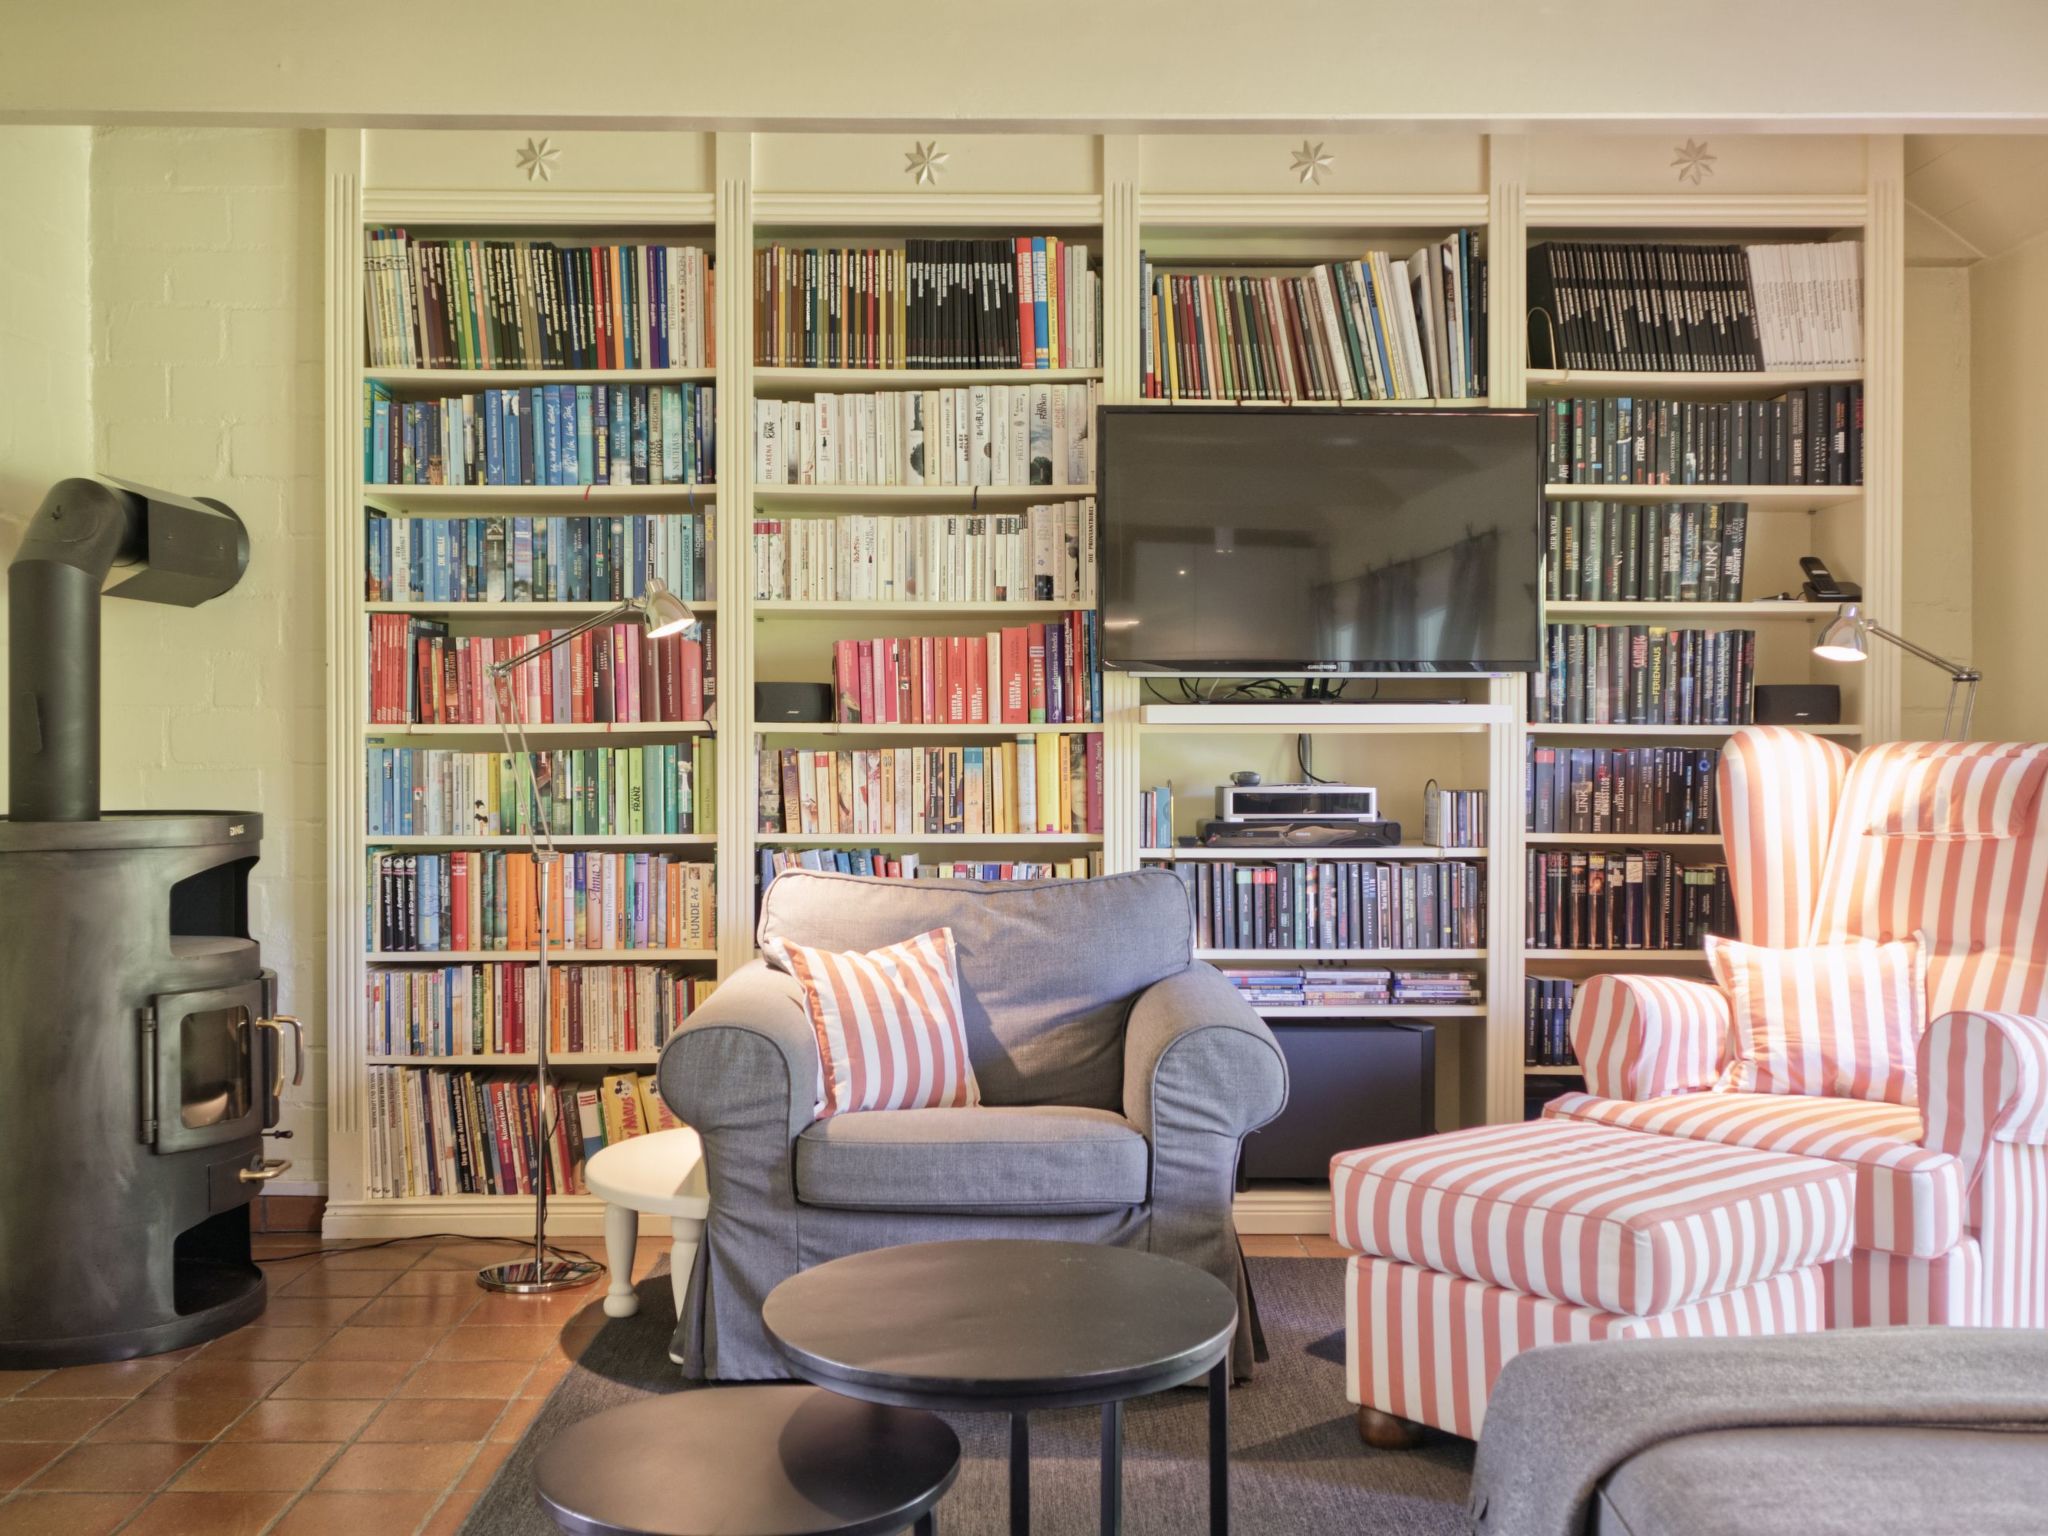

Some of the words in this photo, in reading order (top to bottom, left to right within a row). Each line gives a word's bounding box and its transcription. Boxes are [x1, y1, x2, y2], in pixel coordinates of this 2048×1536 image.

[1023, 252, 1034, 304] HEIMWERKEN
[1037, 251, 1048, 302] RENOVIEREN
[1637, 436, 1645, 462] FITZEK
[1710, 505, 1719, 529] Schuld
[1705, 544, 1718, 580] LINK
[1731, 547, 1743, 584] SLAUGHTER
[633, 786, 641, 812] FRANZ
[1580, 789, 1589, 814] LINK
[588, 864, 601, 904] Anna
[691, 903, 700, 939] HUNDE
[454, 1095, 464, 1133] Airbrushing
[497, 1091, 509, 1141] Kinderlexikon
[458, 1134, 468, 1153] große
